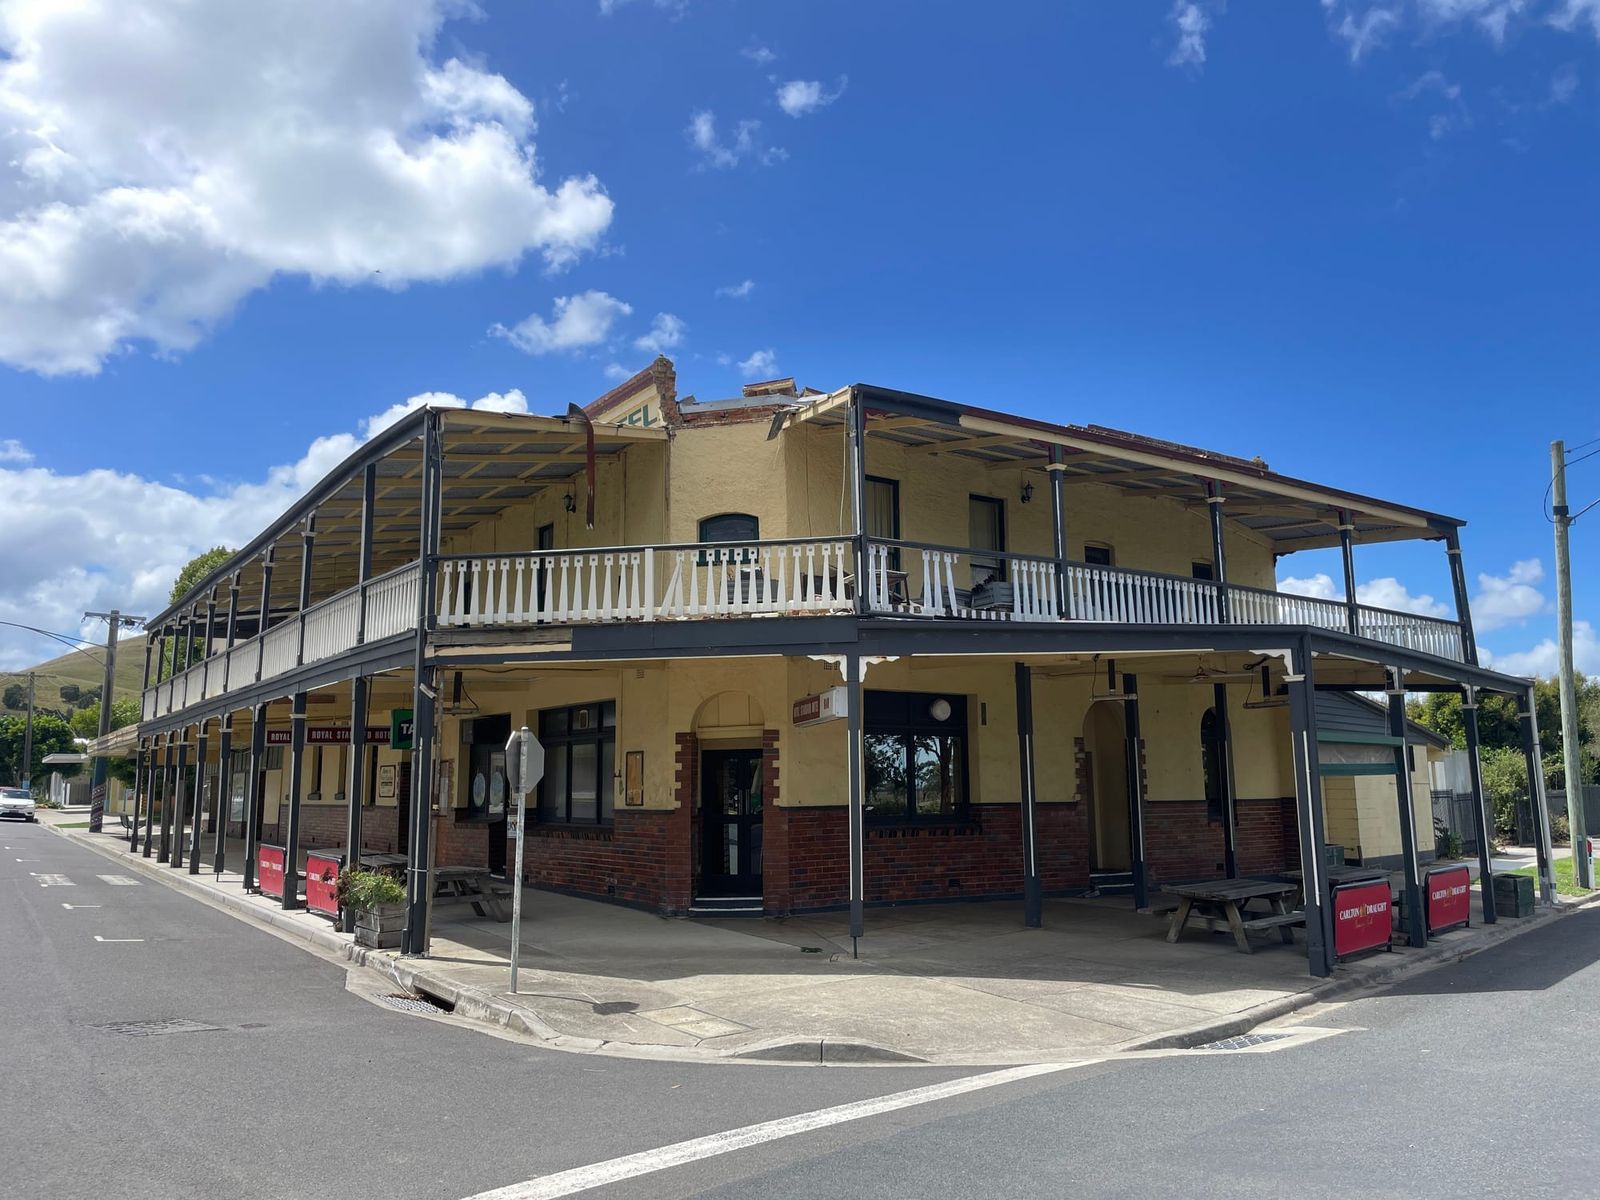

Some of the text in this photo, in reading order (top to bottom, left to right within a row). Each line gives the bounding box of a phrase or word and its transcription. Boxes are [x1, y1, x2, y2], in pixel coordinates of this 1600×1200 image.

[311, 730, 333, 739] ROYAL
[401, 723, 414, 735] TA
[271, 732, 290, 741] ROYAL
[1432, 885, 1467, 901] CARLTON DRAUGHT
[1339, 902, 1387, 920] CARLTON DRAUGHT
